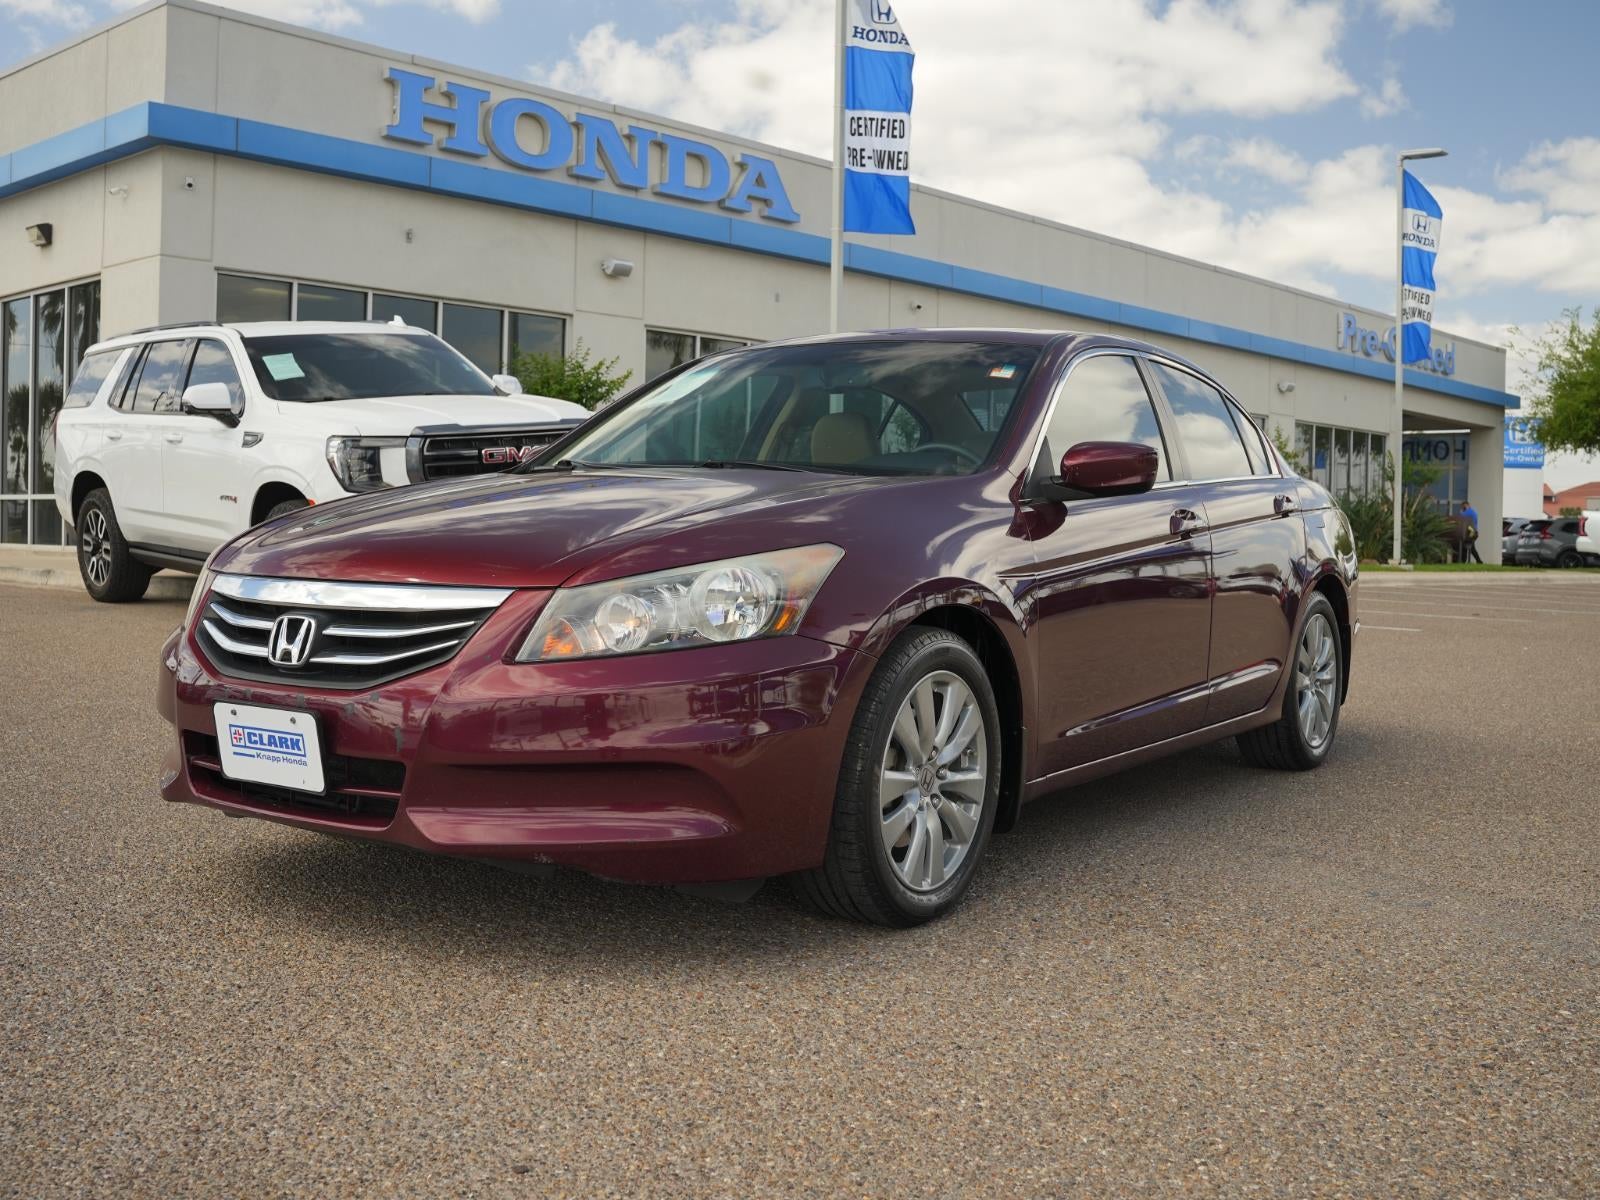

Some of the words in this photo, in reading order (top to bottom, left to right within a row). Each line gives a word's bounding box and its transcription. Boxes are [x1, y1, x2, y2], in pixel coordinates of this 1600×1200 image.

[852, 26, 910, 46] HONDA
[850, 116, 905, 139] CERTIFIED
[383, 67, 800, 223] HONDA
[1403, 288, 1431, 305] TIFIED
[1338, 311, 1456, 376] Pre-ned
[246, 731, 302, 752] CLARK
[256, 752, 281, 764] Knapp
[282, 755, 308, 767] Honda
